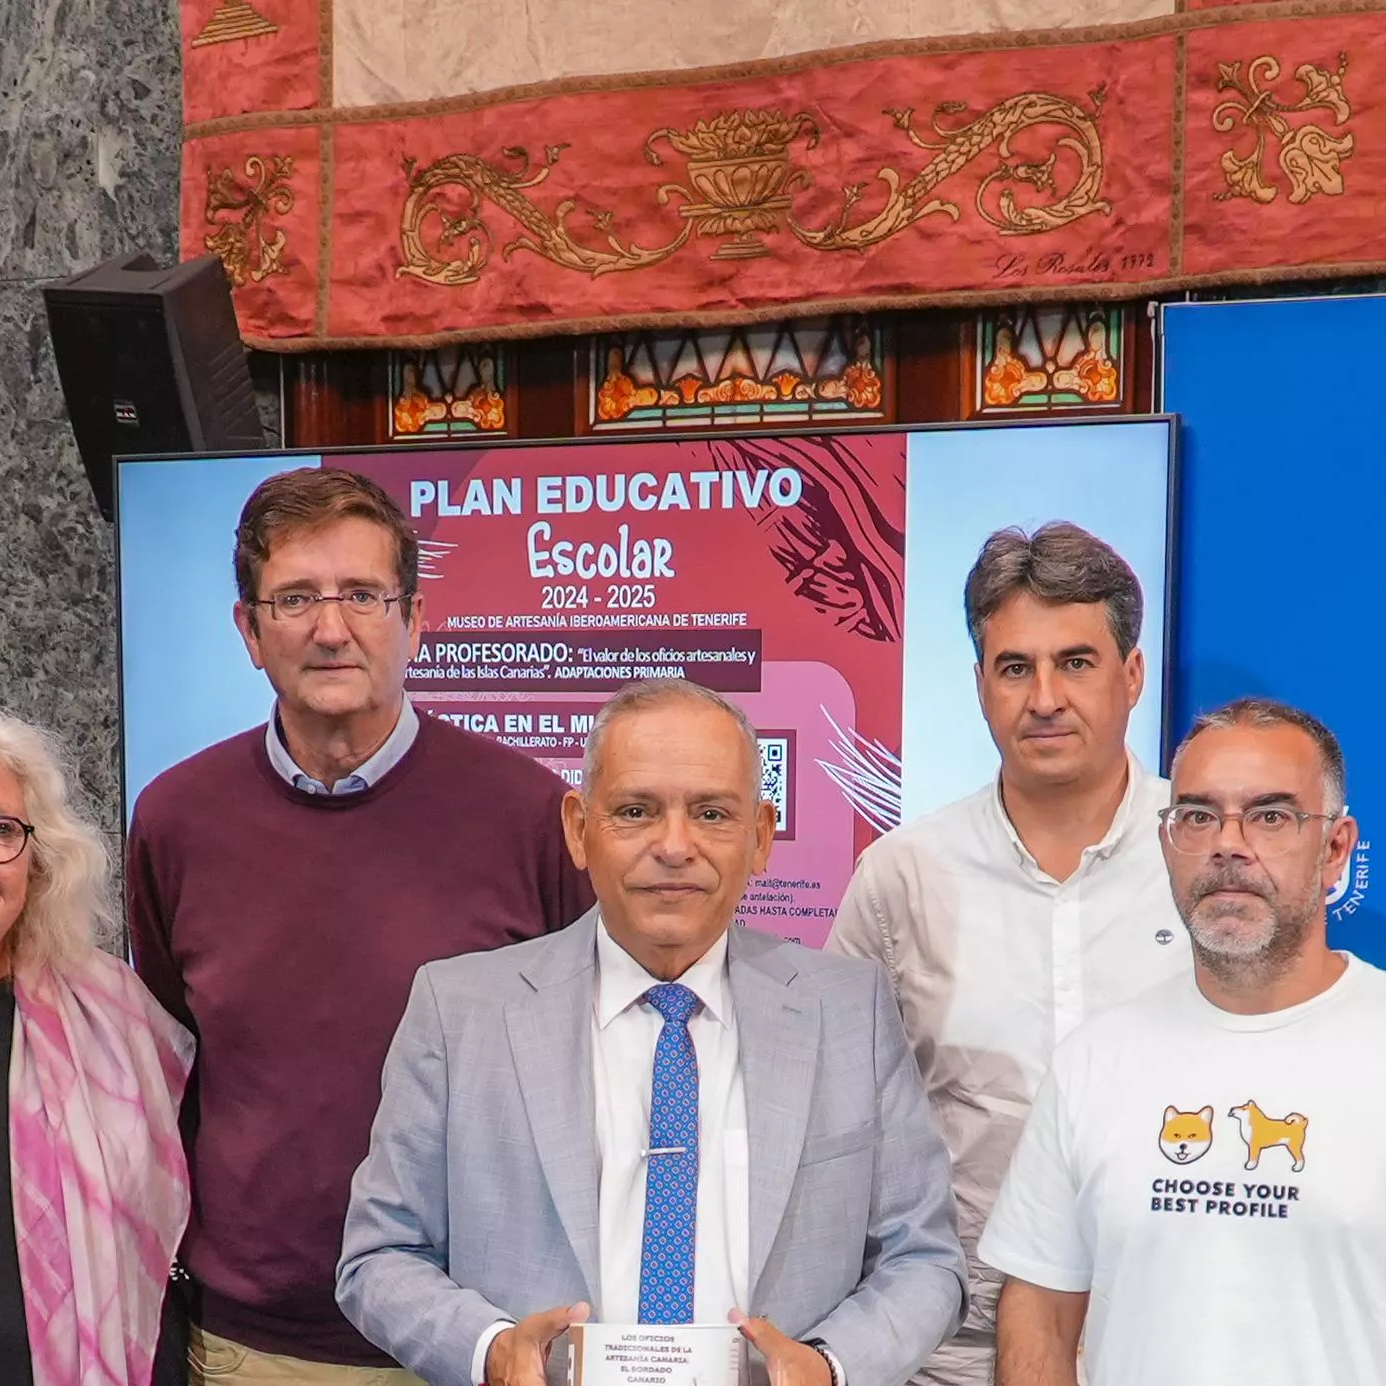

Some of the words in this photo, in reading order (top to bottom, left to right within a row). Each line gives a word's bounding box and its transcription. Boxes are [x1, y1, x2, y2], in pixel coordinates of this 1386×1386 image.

[410, 478, 522, 518] PLAN
[537, 467, 803, 514] EDUCATIVO
[541, 585, 588, 609] 2024
[607, 584, 655, 608] 2025
[447, 616, 485, 628] MUSEO
[488, 616, 503, 628] DE
[505, 612, 568, 628] ARTESANÍA
[570, 614, 670, 628] IBEROAMERICANA
[673, 614, 689, 627] DE
[690, 613, 747, 627] TENERIFE
[436, 643, 573, 663] PROFESORADO:
[593, 648, 619, 662] valor
[620, 648, 634, 662] de
[636, 648, 651, 662] los
[652, 647, 686, 662] oficios
[687, 647, 747, 662] artesanales
[747, 651, 756, 665] y
[446, 664, 461, 679] de
[462, 664, 476, 679] las
[477, 664, 499, 679] Islas
[554, 666, 631, 679] ADAPTACIONES
[633, 666, 686, 678] PRIMARIA
[504, 714, 533, 733] EN
[539, 714, 565, 733] EL
[563, 736, 574, 747] FP
[1332, 840, 1370, 921] TENERIFE
[760, 906, 787, 916] HASTA
[1152, 1178, 1235, 1198] CHOOSE
[1243, 1184, 1300, 1201] YOUR
[1151, 1197, 1199, 1213] BEST
[1206, 1200, 1288, 1219] PROFILE
